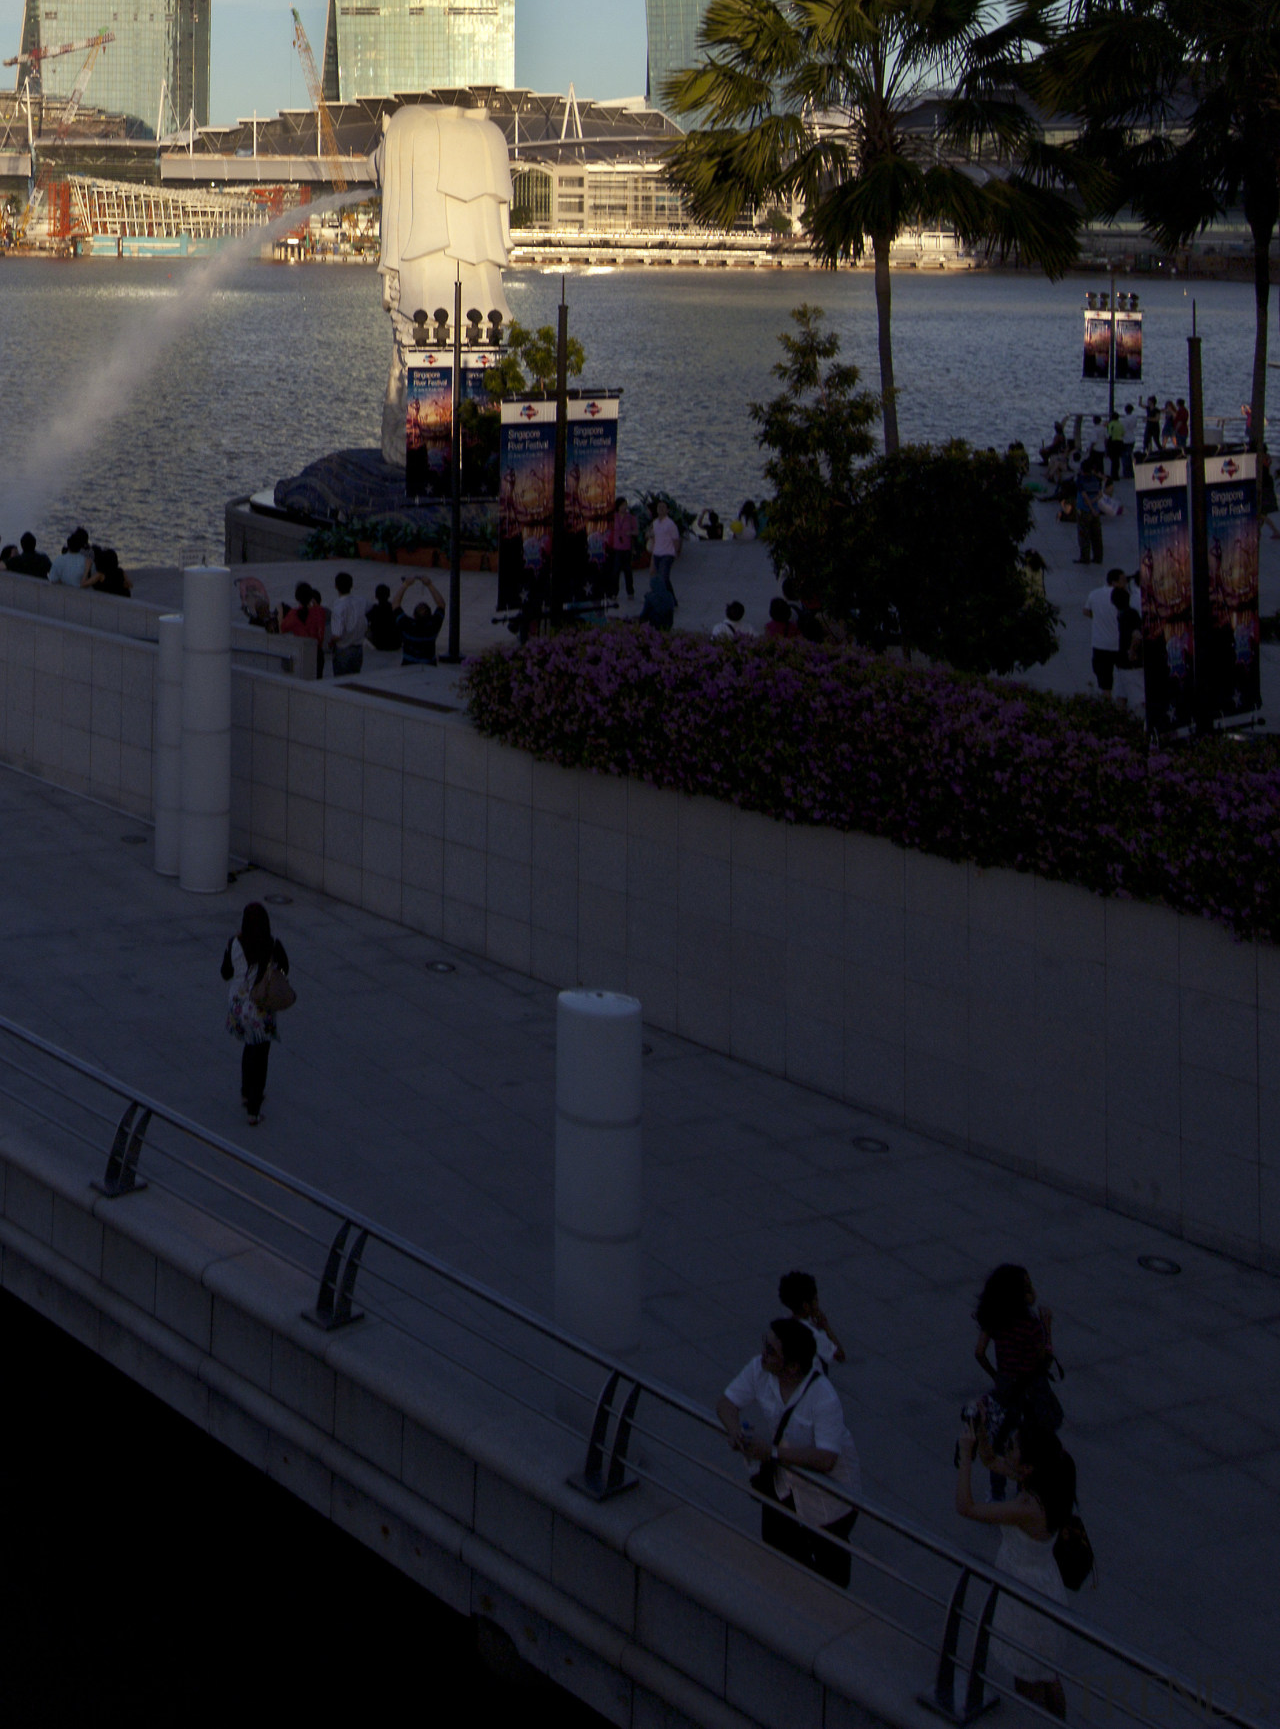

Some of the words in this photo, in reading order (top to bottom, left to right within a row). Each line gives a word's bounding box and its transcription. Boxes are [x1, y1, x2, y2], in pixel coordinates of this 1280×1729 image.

[508, 428, 540, 440] Singapore
[573, 426, 604, 438] Singapore
[507, 441, 523, 451] River
[525, 439, 549, 450] Festival
[573, 437, 588, 447] River
[589, 436, 611, 447] Festival
[1143, 497, 1172, 511] Singapore
[1211, 491, 1243, 505] Singapore
[1212, 506, 1227, 517] River
[1230, 503, 1250, 516] Festival
[1144, 513, 1158, 525] River
[1161, 510, 1181, 523] Festival
